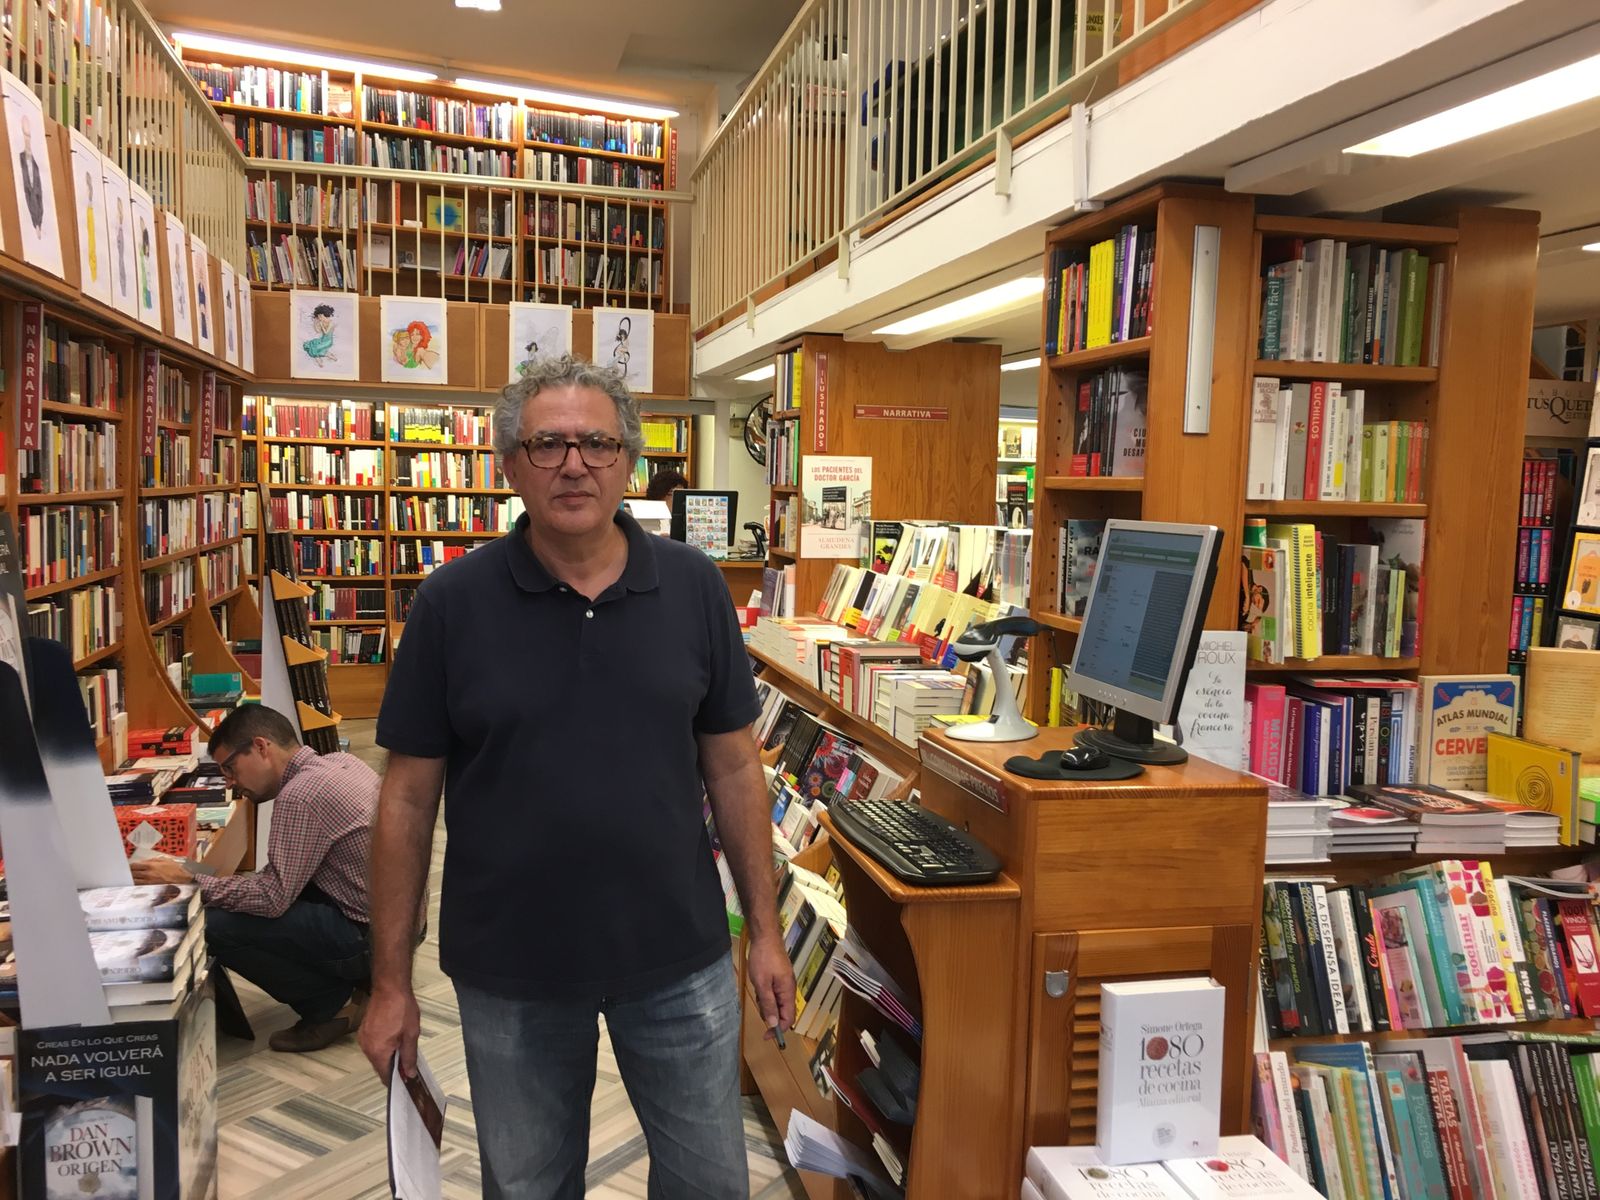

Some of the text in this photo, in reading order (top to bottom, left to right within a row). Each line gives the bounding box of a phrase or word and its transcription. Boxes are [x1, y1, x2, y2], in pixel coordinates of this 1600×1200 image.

[23, 324, 36, 446] NARRATIVA
[144, 364, 156, 454] NARRATIVA
[883, 408, 931, 418] NARRATIVA
[1311, 386, 1323, 439] CUCHILLOS
[202, 383, 213, 457] NARRATIVA
[814, 473, 860, 482] DOCTOR GARCÍA
[822, 465, 853, 474] PACIENTES
[1304, 553, 1314, 632] cocina inteligente
[1197, 651, 1236, 665] ROUX
[1437, 709, 1509, 727] ATLAS MUNDIAL
[1435, 737, 1488, 755] CERVE
[1487, 889, 1498, 917] cocina
[1564, 916, 1587, 924] VINOS
[1316, 895, 1344, 1014] LA DESPENSA IDEAL
[1458, 913, 1480, 977] cocinar
[1520, 970, 1537, 1011] EL PAN
[1140, 1021, 1203, 1036] Simone Ortega
[31, 1045, 164, 1068] NADA VOLVERÁ
[45, 1064, 151, 1083] A SER IGUAL
[1139, 1060, 1201, 1080] recetas
[1279, 1062, 1291, 1097] mundo
[1138, 1078, 1201, 1095] de cocina
[1285, 1098, 1295, 1116] del
[1439, 1076, 1456, 1128] TARTAS
[70, 1122, 109, 1142] DAN
[49, 1136, 134, 1163] BROWN
[57, 1158, 123, 1177] ORIGEN
